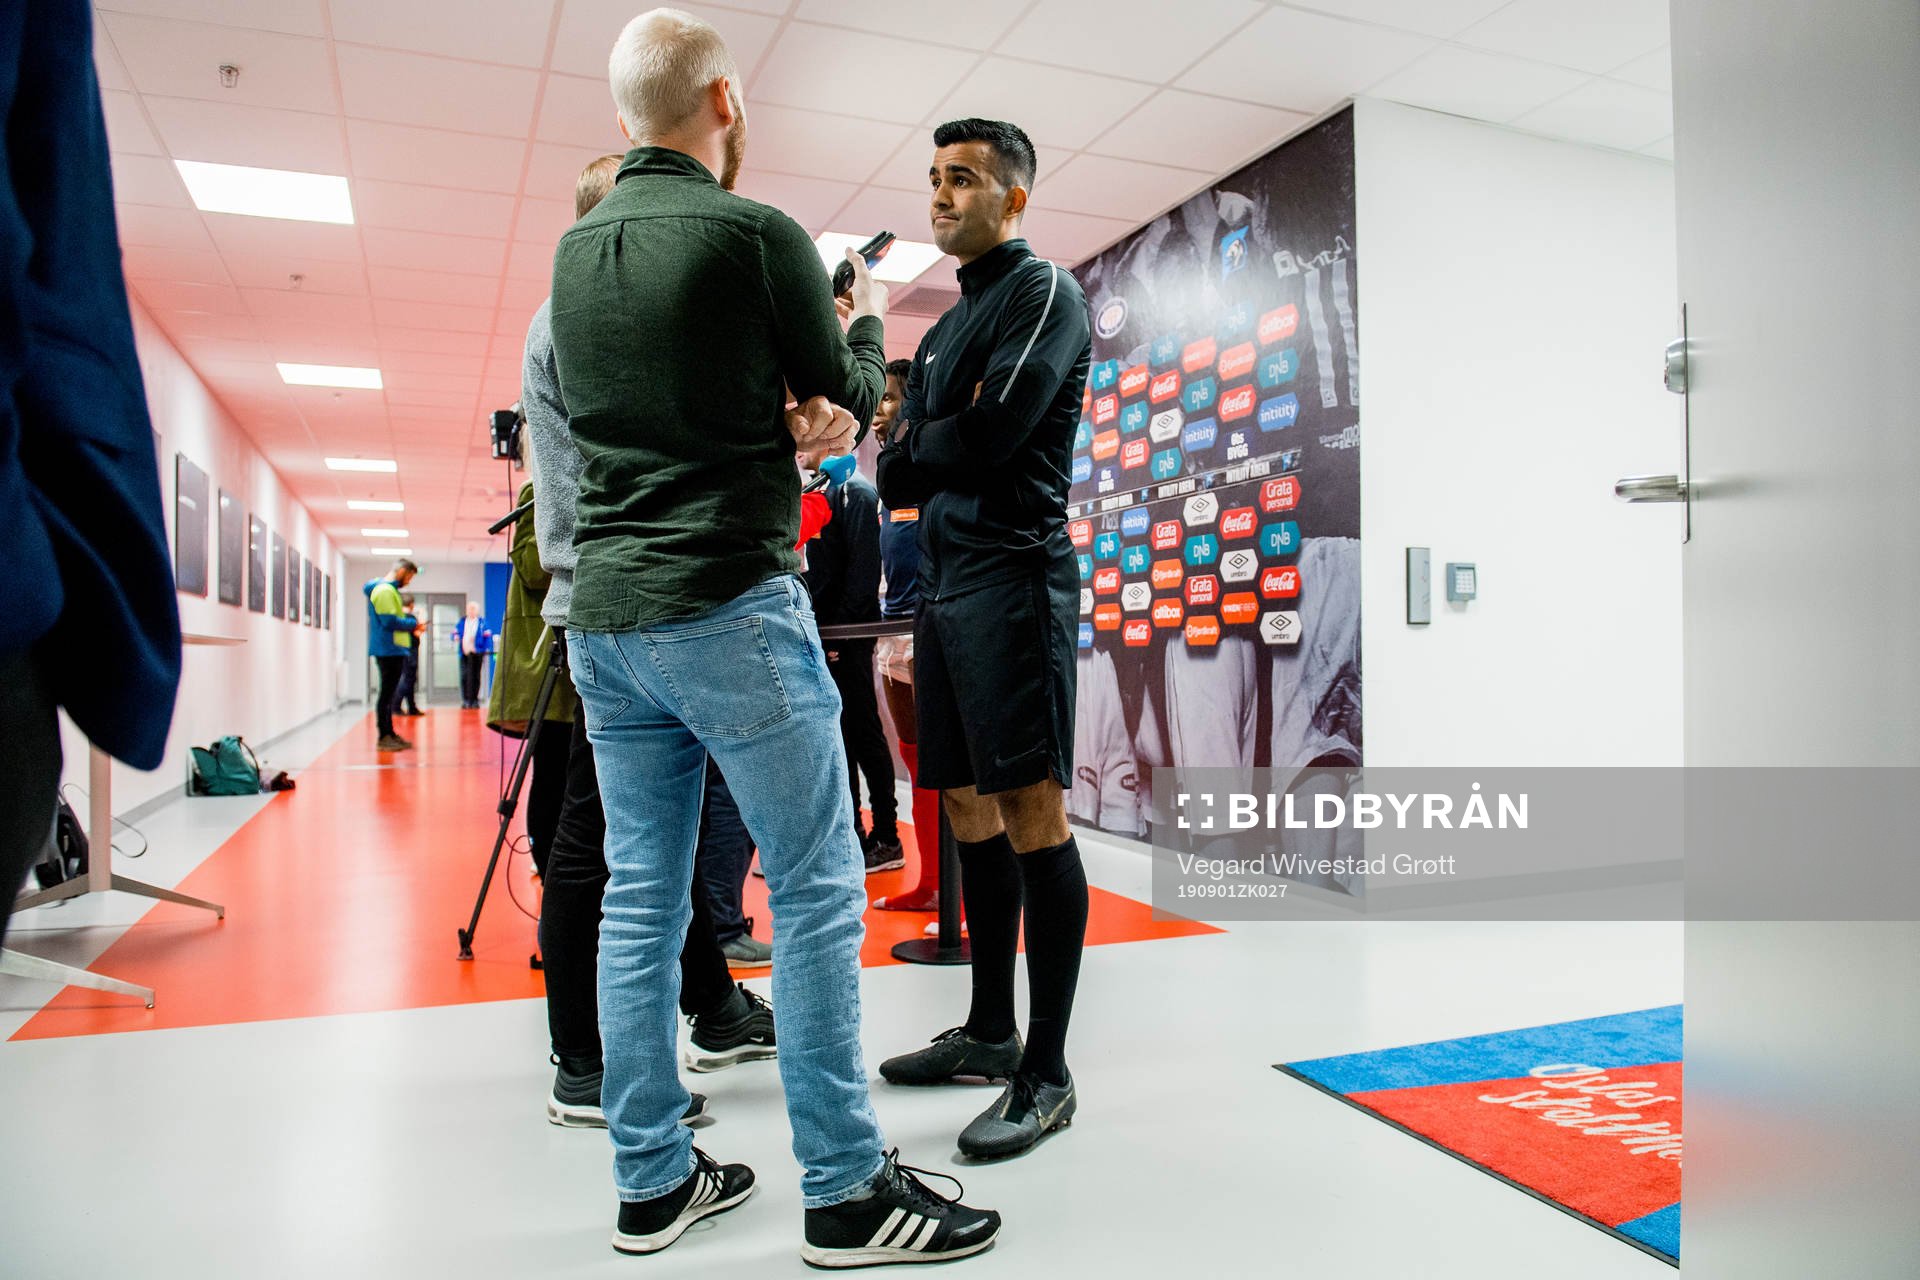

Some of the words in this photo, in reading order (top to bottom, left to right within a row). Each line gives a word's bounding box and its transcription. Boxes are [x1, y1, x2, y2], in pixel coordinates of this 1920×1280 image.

[1260, 401, 1297, 423] intility
[1185, 426, 1215, 444] intility
[1125, 442, 1144, 458] Grata
[1266, 481, 1293, 498] Grata
[1266, 496, 1293, 512] personal
[1156, 524, 1177, 538] Grata
[1223, 512, 1253, 533] Coca-Cola
[1190, 578, 1212, 593] Grata
[1263, 572, 1297, 592] Coca-Cola
[1154, 605, 1181, 620] altibox
[1529, 1063, 1676, 1108] Oslos
